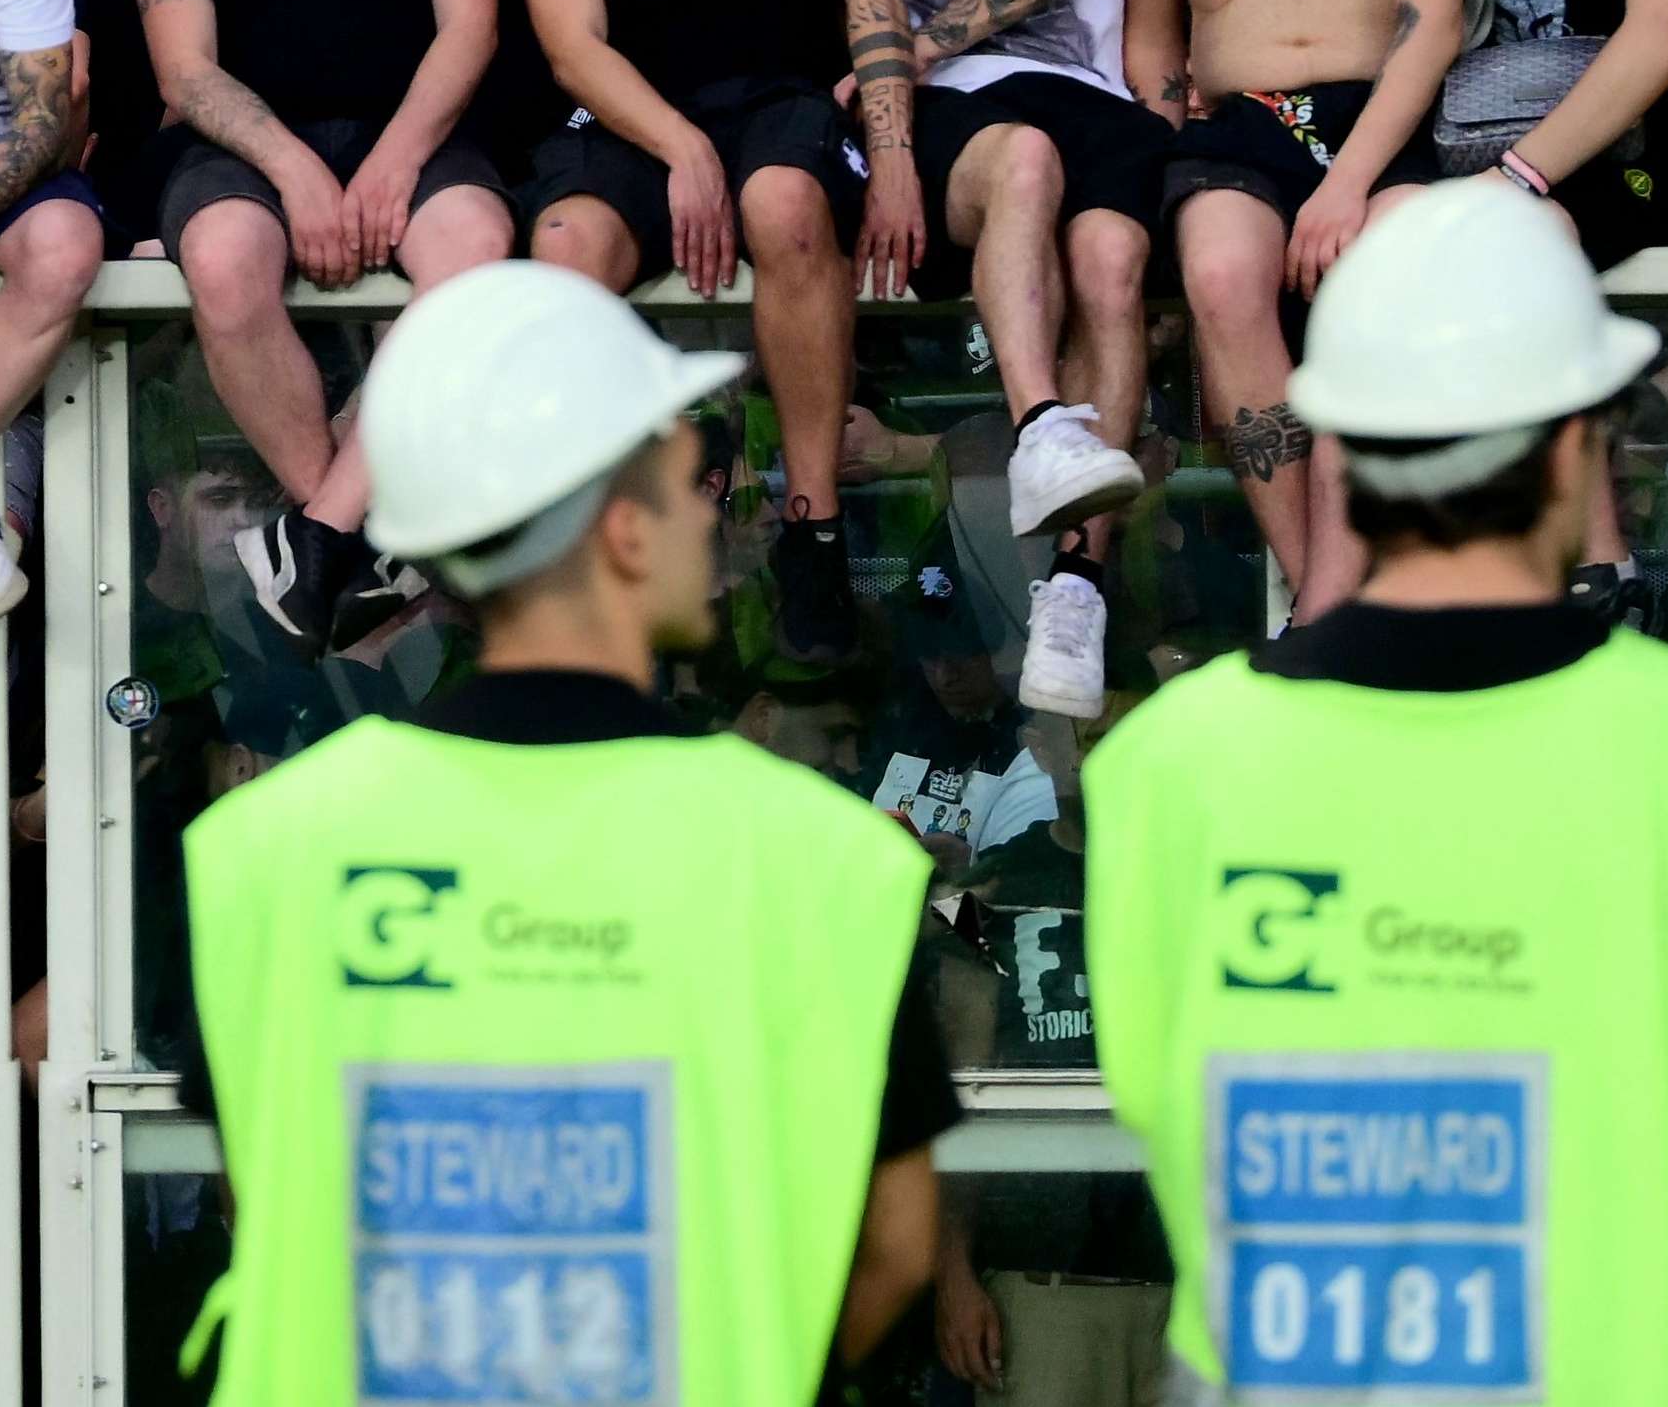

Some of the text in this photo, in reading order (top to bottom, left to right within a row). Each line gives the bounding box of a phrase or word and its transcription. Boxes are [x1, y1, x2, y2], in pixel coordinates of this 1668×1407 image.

[1364, 906, 1526, 968] Group
[363, 1123, 634, 1209] STEWARD
[1234, 1110, 1516, 1195] STEWARD
[366, 1264, 629, 1378] 0112
[1250, 1258, 1497, 1363] 0181
